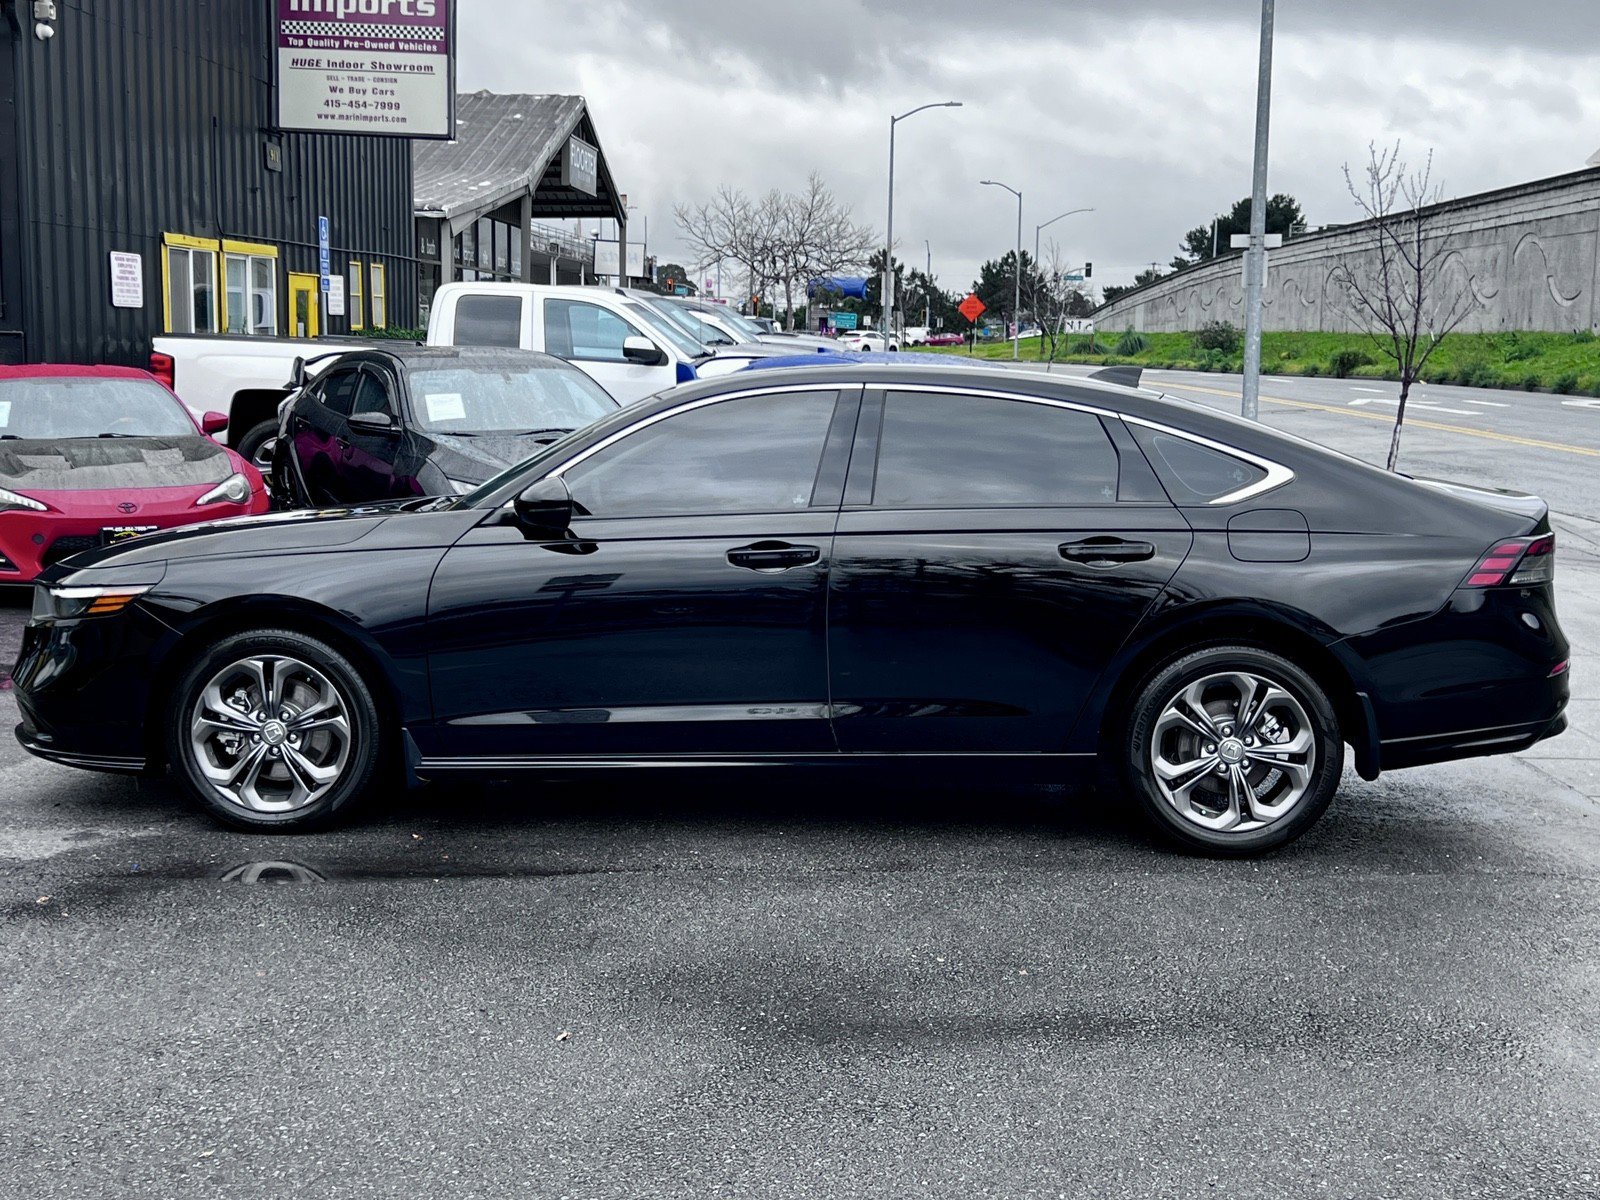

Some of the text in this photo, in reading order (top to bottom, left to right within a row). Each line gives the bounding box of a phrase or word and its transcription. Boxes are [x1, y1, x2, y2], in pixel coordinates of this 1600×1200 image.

[288, 37, 438, 52] Top Quality Pre-Owned Vehicles
[291, 58, 434, 72] HUGE Indoor Showroom
[329, 85, 395, 96] We Buy Cars
[324, 99, 401, 111] 415-454-7999
[317, 112, 408, 123] www.marinimports.com
